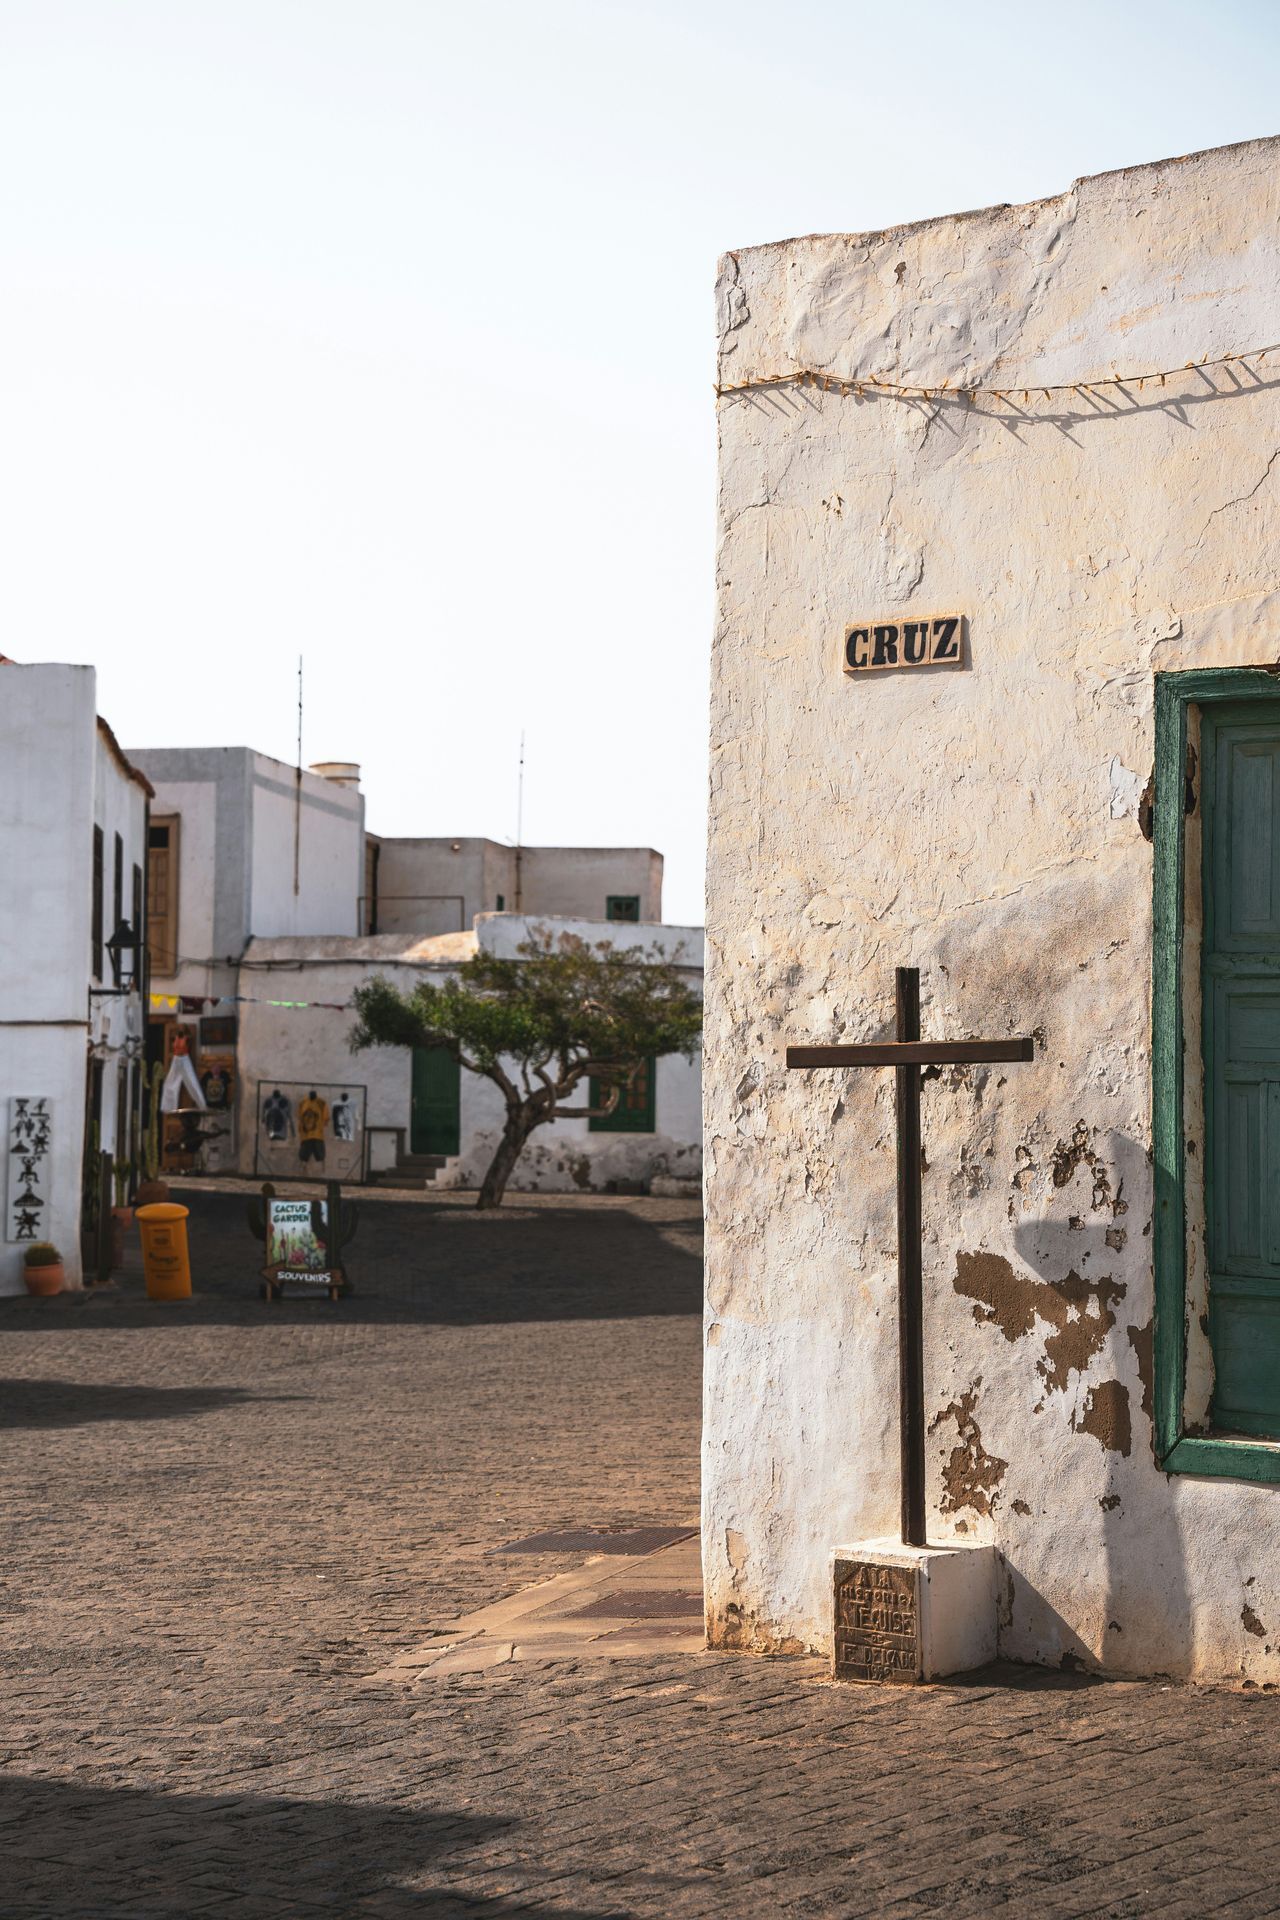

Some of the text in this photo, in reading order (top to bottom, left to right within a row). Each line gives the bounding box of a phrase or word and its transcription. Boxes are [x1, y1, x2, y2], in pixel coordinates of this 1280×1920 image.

[845, 618, 959, 668] CRUZ
[275, 1204, 308, 1214] CACTUS
[273, 1214, 309, 1223] GARDEN
[277, 1271, 332, 1283] SOUVENIRS
[849, 1600, 915, 1635] TEGUISE
[872, 1634, 884, 1644] DE
